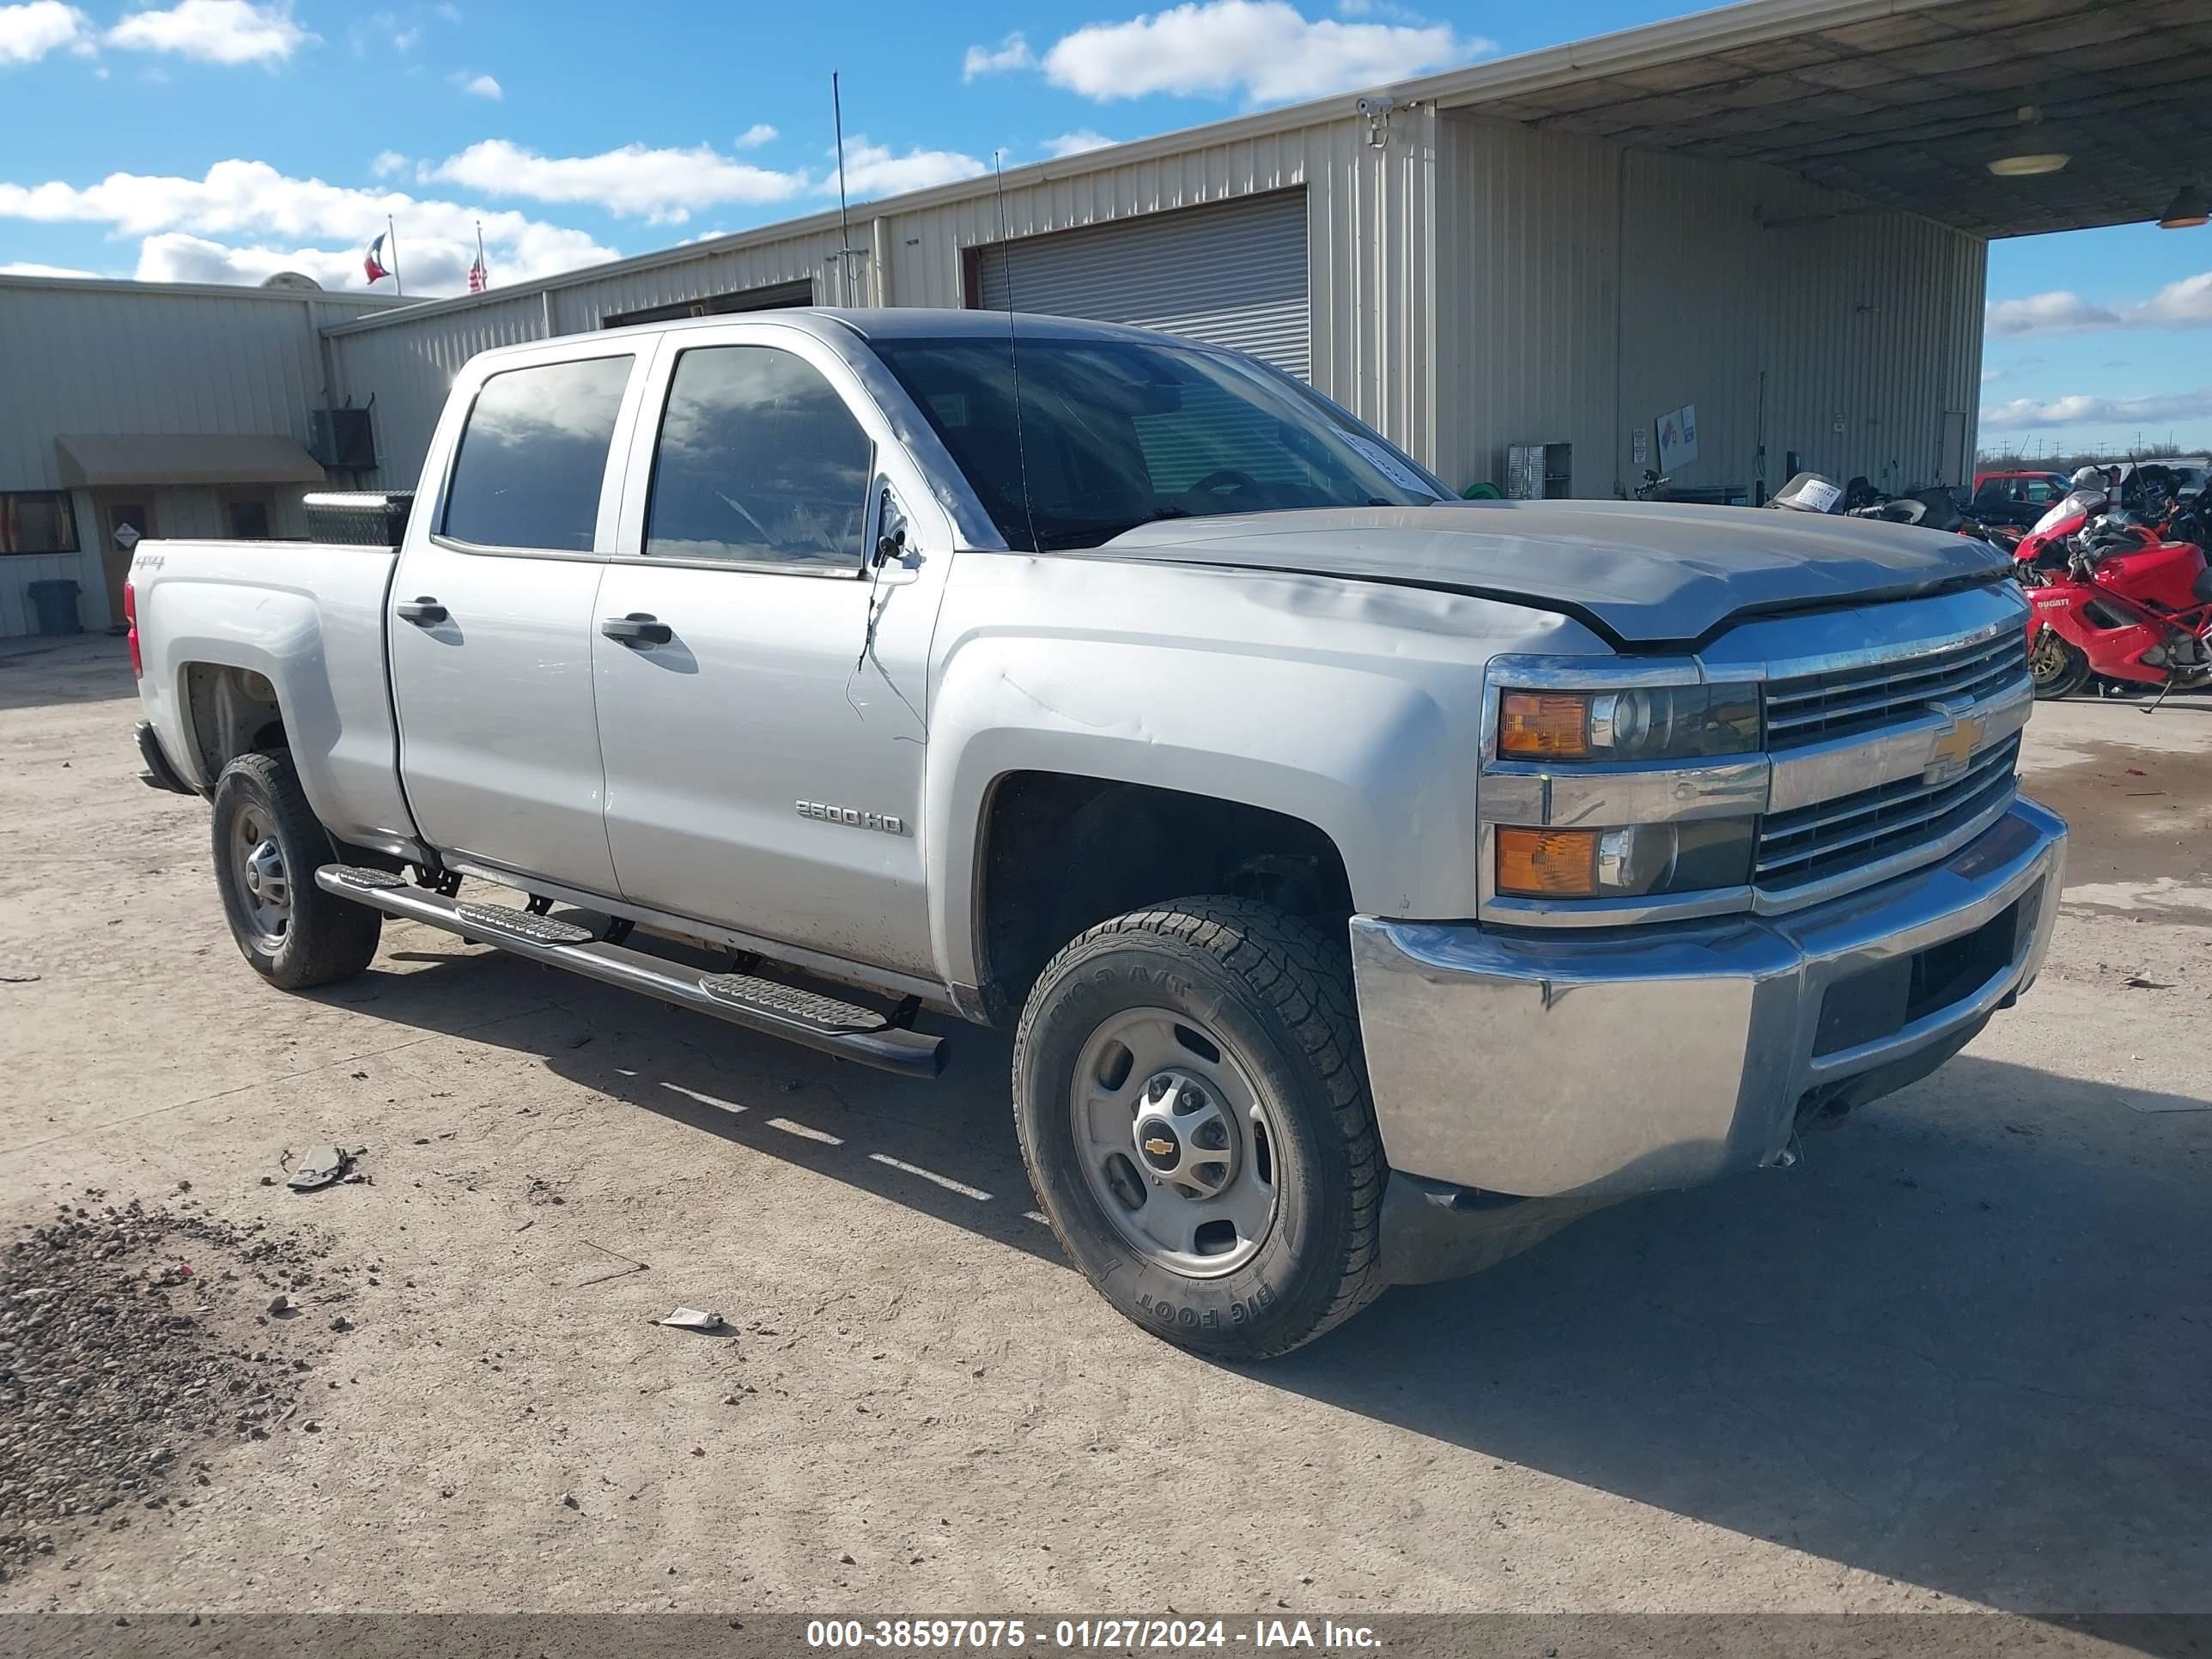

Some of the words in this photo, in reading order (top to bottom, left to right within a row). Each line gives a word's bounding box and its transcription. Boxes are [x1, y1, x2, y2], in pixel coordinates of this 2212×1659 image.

[2037, 598, 2069, 608] DUCATI
[1134, 1291, 1219, 1329] FOOT
[1231, 1279, 1277, 1325] BIG
